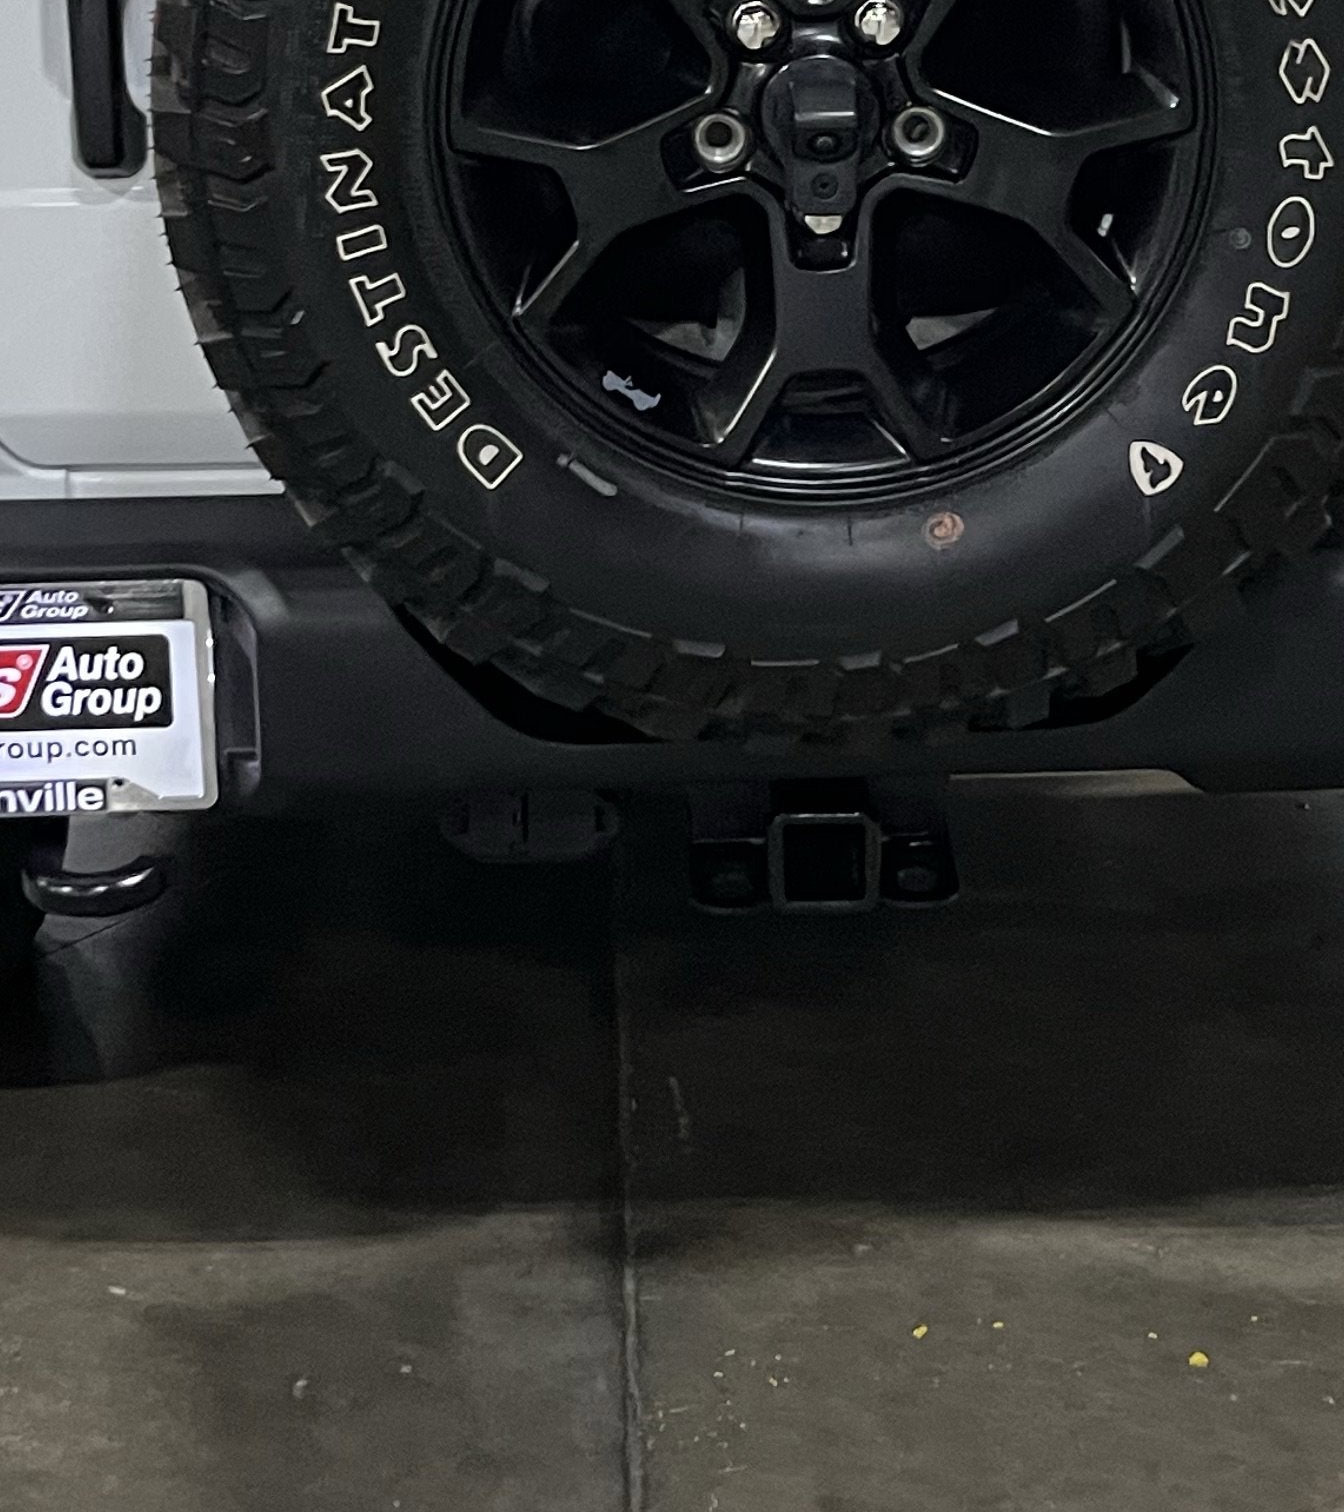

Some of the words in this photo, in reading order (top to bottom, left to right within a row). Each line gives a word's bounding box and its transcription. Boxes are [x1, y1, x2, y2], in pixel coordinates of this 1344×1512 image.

[24, 590, 79, 604] Auto
[20, 604, 89, 619] Group
[46, 646, 144, 682] Auto
[41, 684, 162, 721] Group
